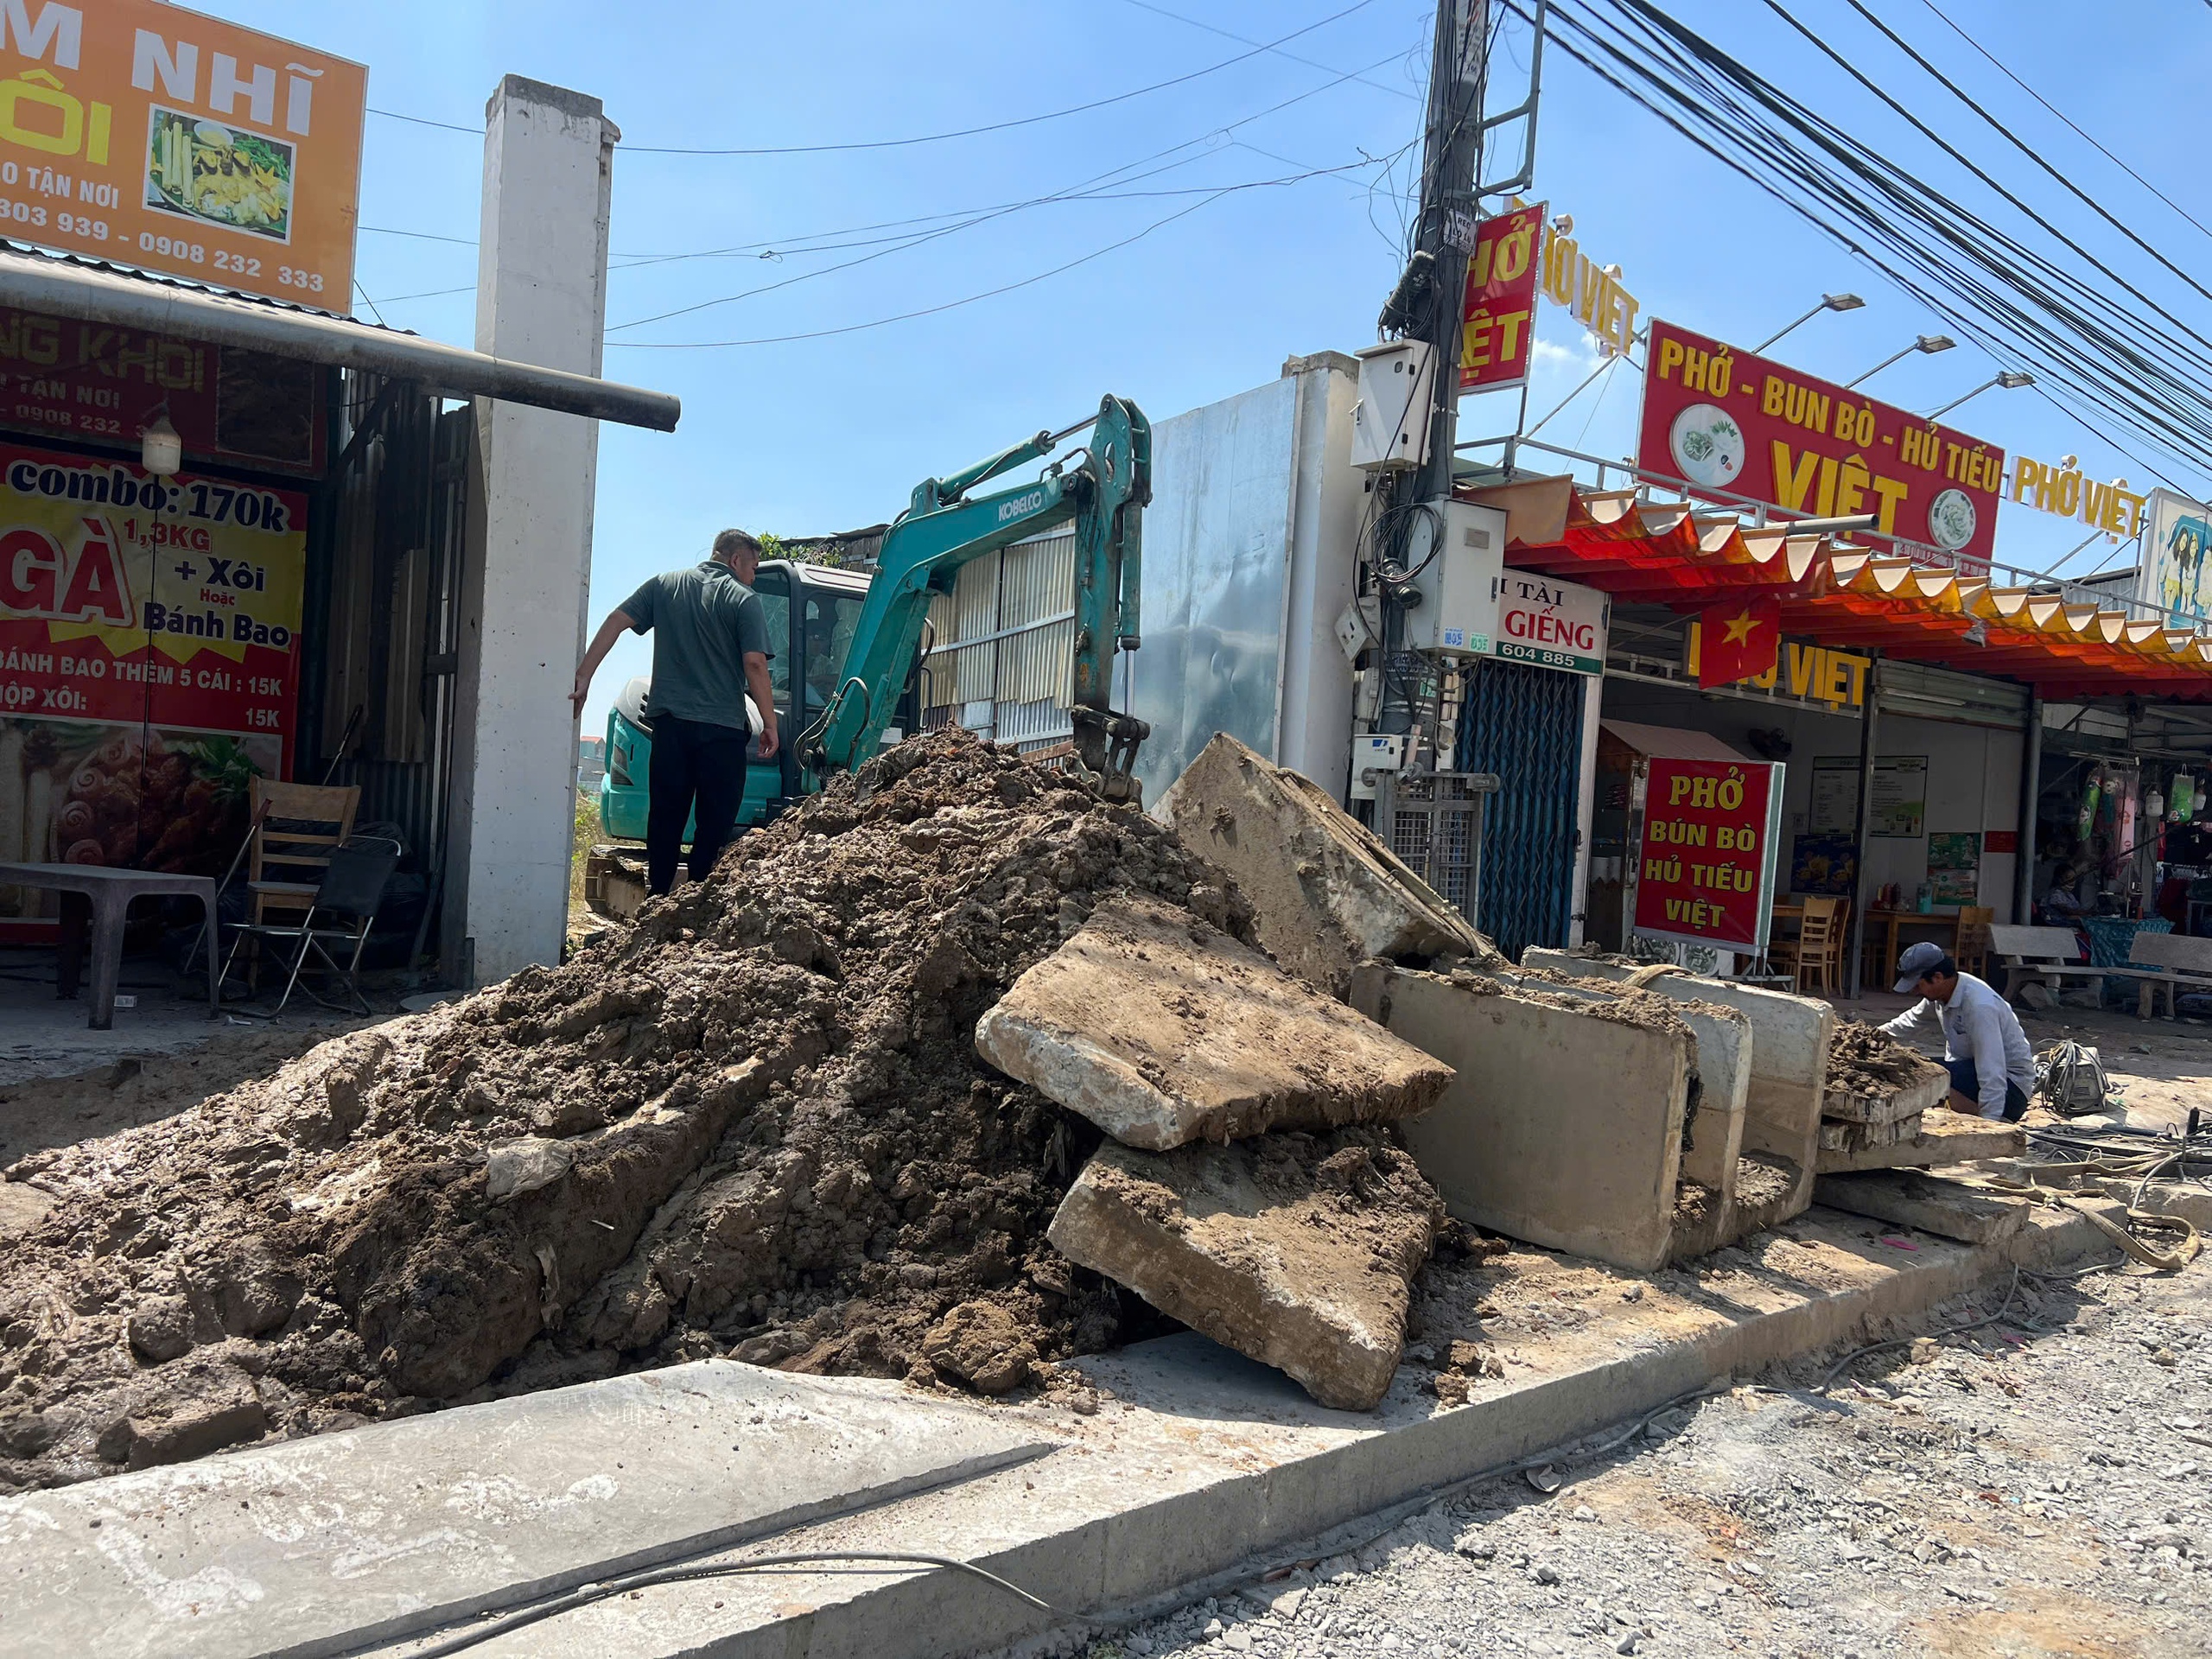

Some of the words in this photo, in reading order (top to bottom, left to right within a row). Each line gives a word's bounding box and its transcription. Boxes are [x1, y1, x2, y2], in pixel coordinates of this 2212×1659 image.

[131, 28, 324, 137] NHĨ
[27, 166, 71, 198] TẬN
[79, 180, 119, 209] NƠI
[57, 213, 109, 240] 939
[139, 232, 205, 264] 0908
[214, 251, 262, 277] 232
[278, 265, 324, 292] 333
[16, 404, 73, 427] 0908
[79, 415, 121, 434] 232
[1659, 343, 1733, 398] PHỞ
[1834, 400, 1877, 448] BÒ
[1901, 423, 1941, 472] HỦ
[1945, 444, 2002, 493] TIẾU
[998, 491, 1042, 522] KOBELCO
[2011, 454, 2082, 518] PHỞ
[2079, 478, 2147, 544] VIỆT
[123, 518, 212, 552] 1,3KG
[207, 556, 264, 592] Xôi
[200, 588, 235, 607] Hoặc
[1517, 582, 1564, 607] TÀI
[143, 602, 224, 639] Bánh
[233, 613, 291, 647] Bao
[1504, 606, 1594, 651] GIẾNG
[1502, 643, 1536, 661] 604
[1542, 649, 1576, 668] 885
[60, 655, 106, 678] BAO
[113, 659, 174, 686] THÊM
[180, 669, 192, 687] 5
[197, 667, 231, 691] CÁI
[248, 677, 283, 696] 15K
[41, 686, 87, 710] XÔI:
[246, 709, 280, 728] 15K
[1669, 766, 1745, 810] PHỞ
[1649, 820, 1707, 849] BÚN
[1716, 823, 1757, 852] BÒ
[1645, 854, 1681, 883] HỦ
[1690, 861, 1753, 893] TIẾU
[1665, 899, 1726, 931] VIỆT
